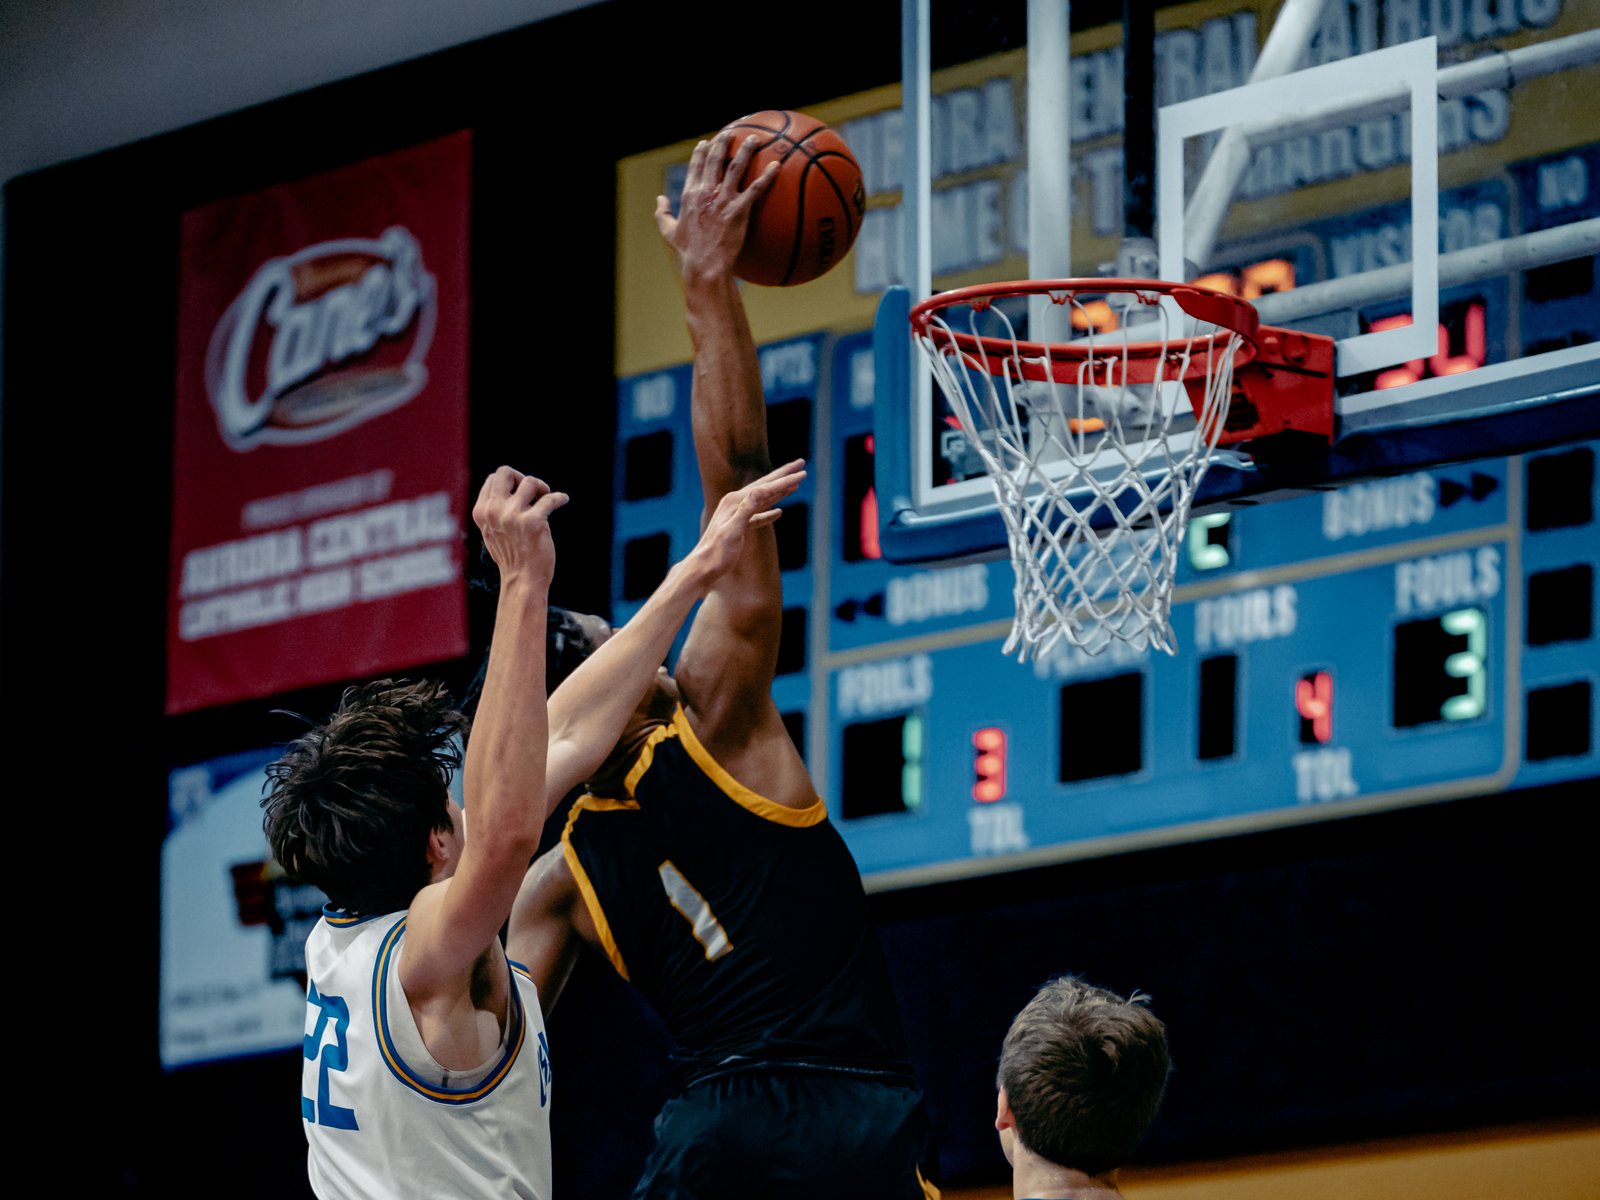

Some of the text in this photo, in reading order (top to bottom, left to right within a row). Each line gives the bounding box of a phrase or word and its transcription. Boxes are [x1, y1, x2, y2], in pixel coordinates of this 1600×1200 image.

[1394, 546, 1501, 614] FOULS
[1194, 584, 1298, 651] FOULS
[1440, 608, 1489, 721] 3
[1295, 671, 1334, 743] 4
[972, 727, 1007, 803] 3
[658, 859, 735, 963] 1
